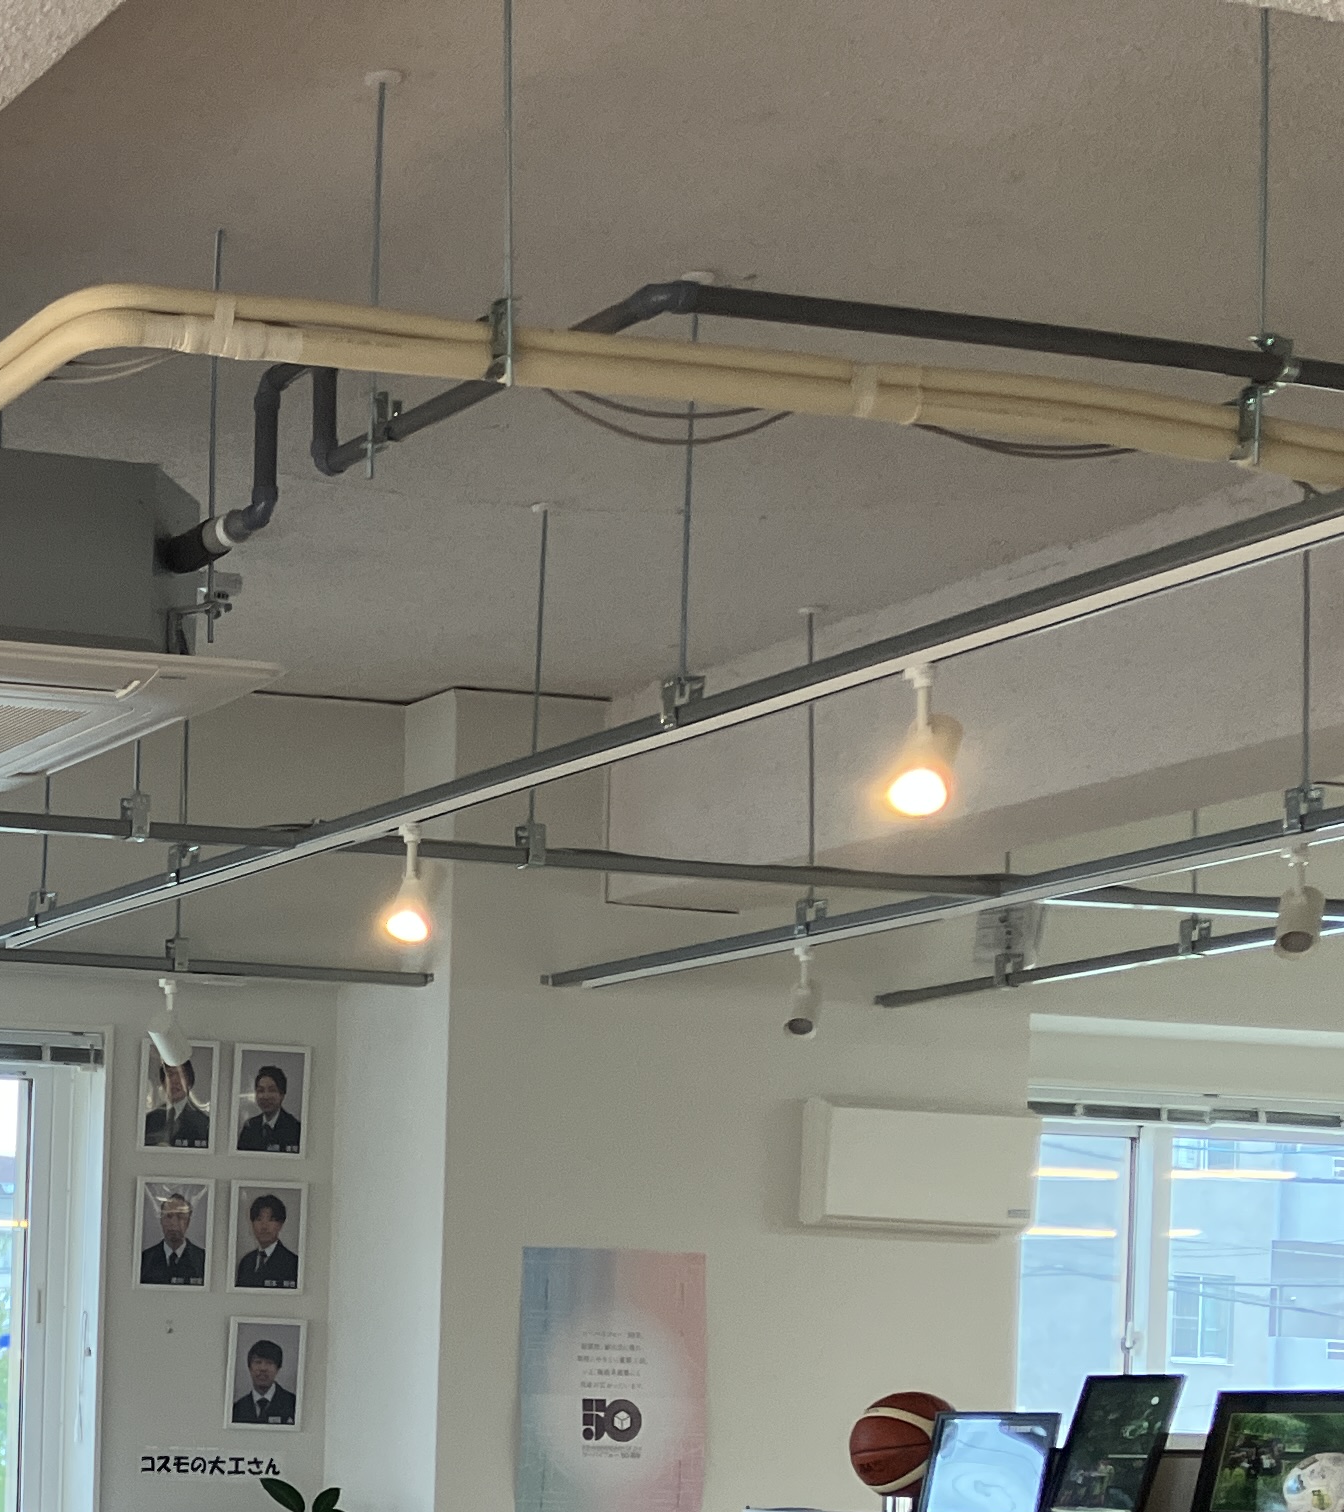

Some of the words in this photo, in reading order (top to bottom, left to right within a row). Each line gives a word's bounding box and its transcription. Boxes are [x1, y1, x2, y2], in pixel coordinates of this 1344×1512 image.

[141, 1455, 281, 1476] コスモの大工さん
